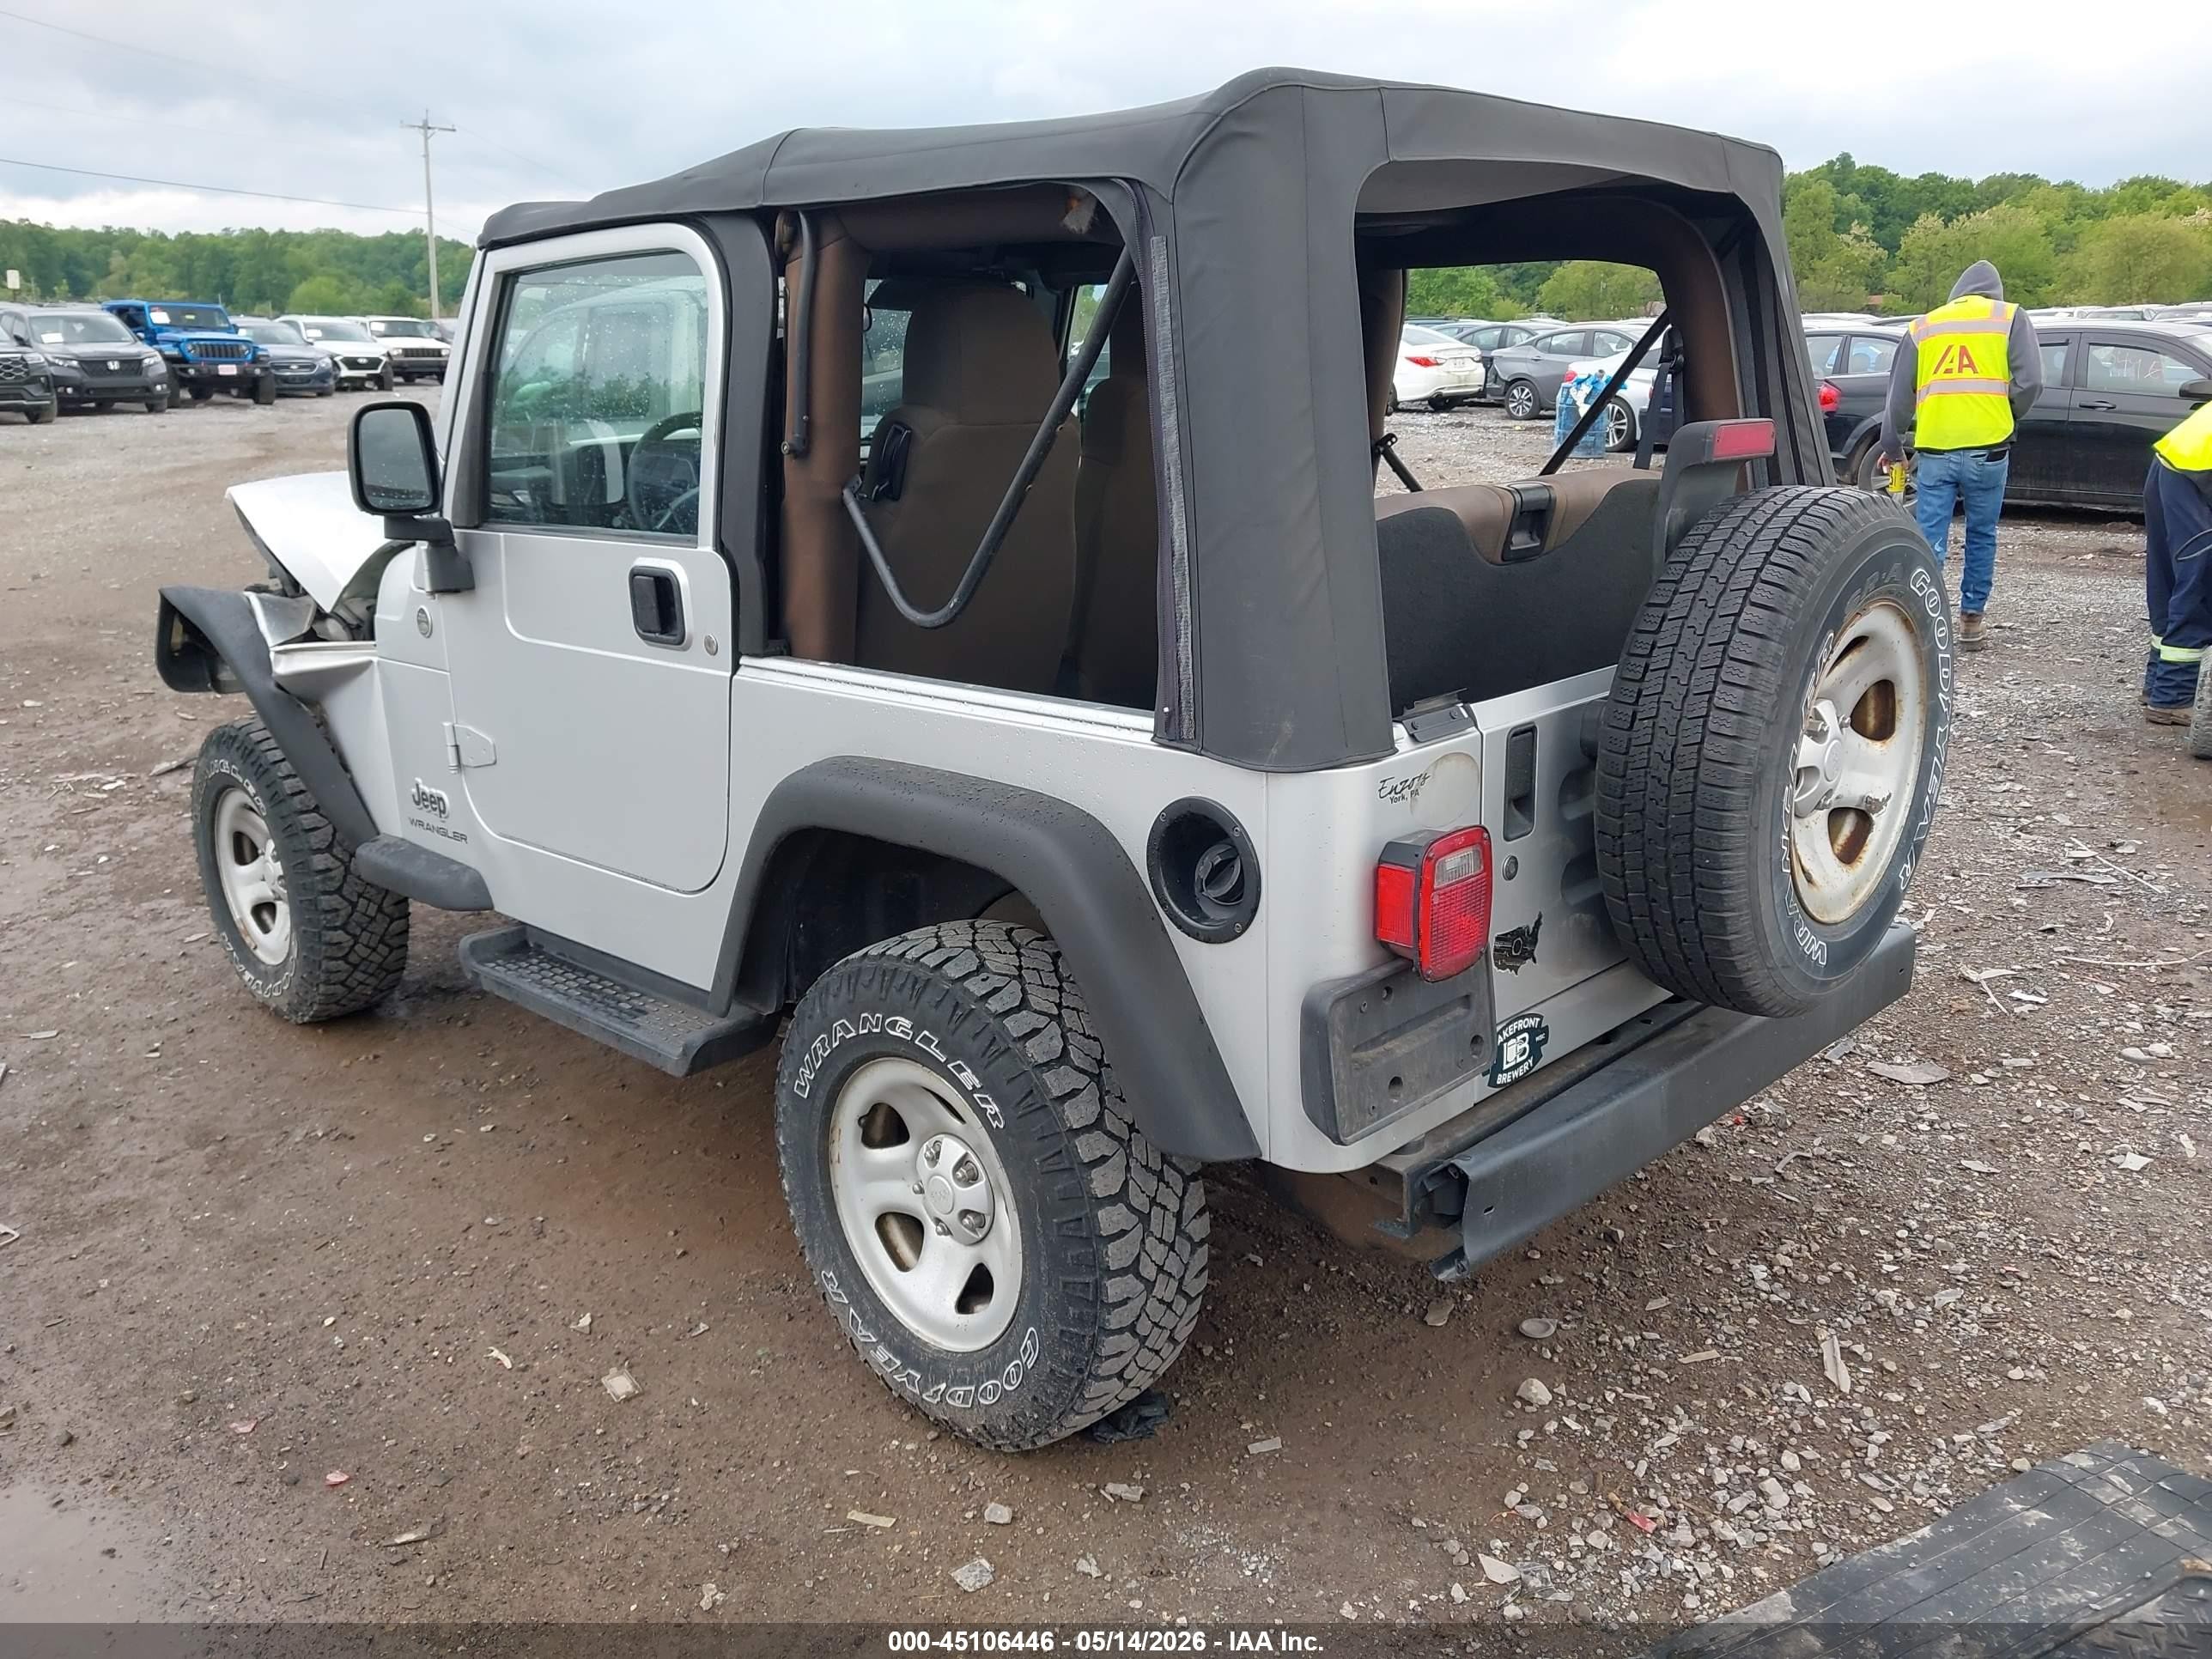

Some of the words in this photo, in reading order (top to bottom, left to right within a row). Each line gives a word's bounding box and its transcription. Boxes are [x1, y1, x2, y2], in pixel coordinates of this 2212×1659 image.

[1898, 568, 1952, 890] GOODYEAR
[412, 781, 447, 819] Jeep
[1389, 793, 1408, 805] York,
[1410, 788, 1419, 798] PA
[408, 817, 468, 844] WRANGLER
[1497, 1017, 1540, 1046] AKEFRONT
[793, 1012, 1006, 1130] WRANGLER
[1496, 1055, 1534, 1085] BREWERY
[821, 1270, 1040, 1408] GOODYEAR
